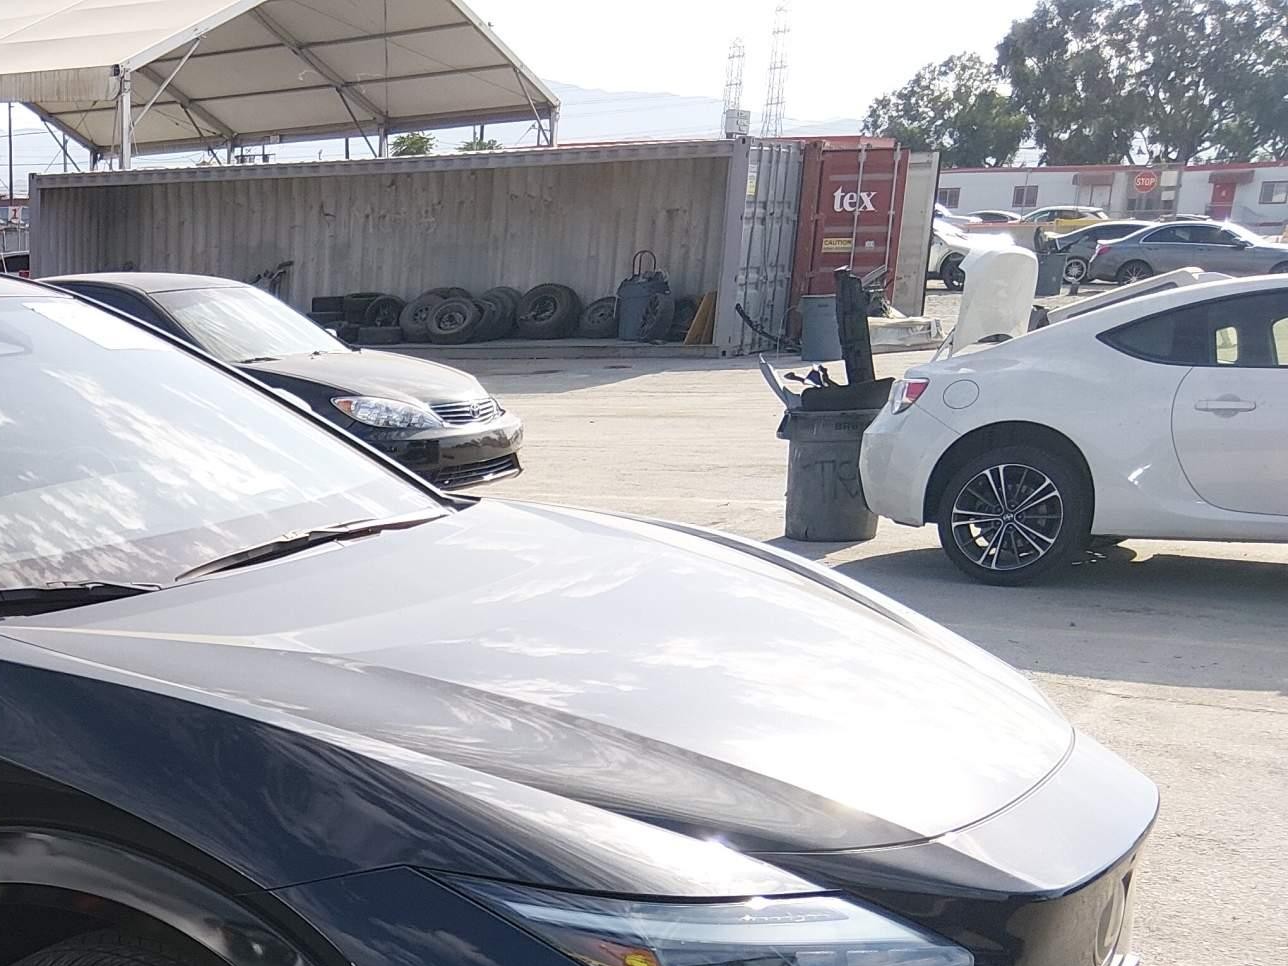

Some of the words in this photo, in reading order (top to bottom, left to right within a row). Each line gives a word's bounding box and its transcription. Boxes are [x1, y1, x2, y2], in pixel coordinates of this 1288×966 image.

[1135, 177, 1156, 186] STOP
[833, 185, 878, 212] tex
[11, 208, 18, 220] 1
